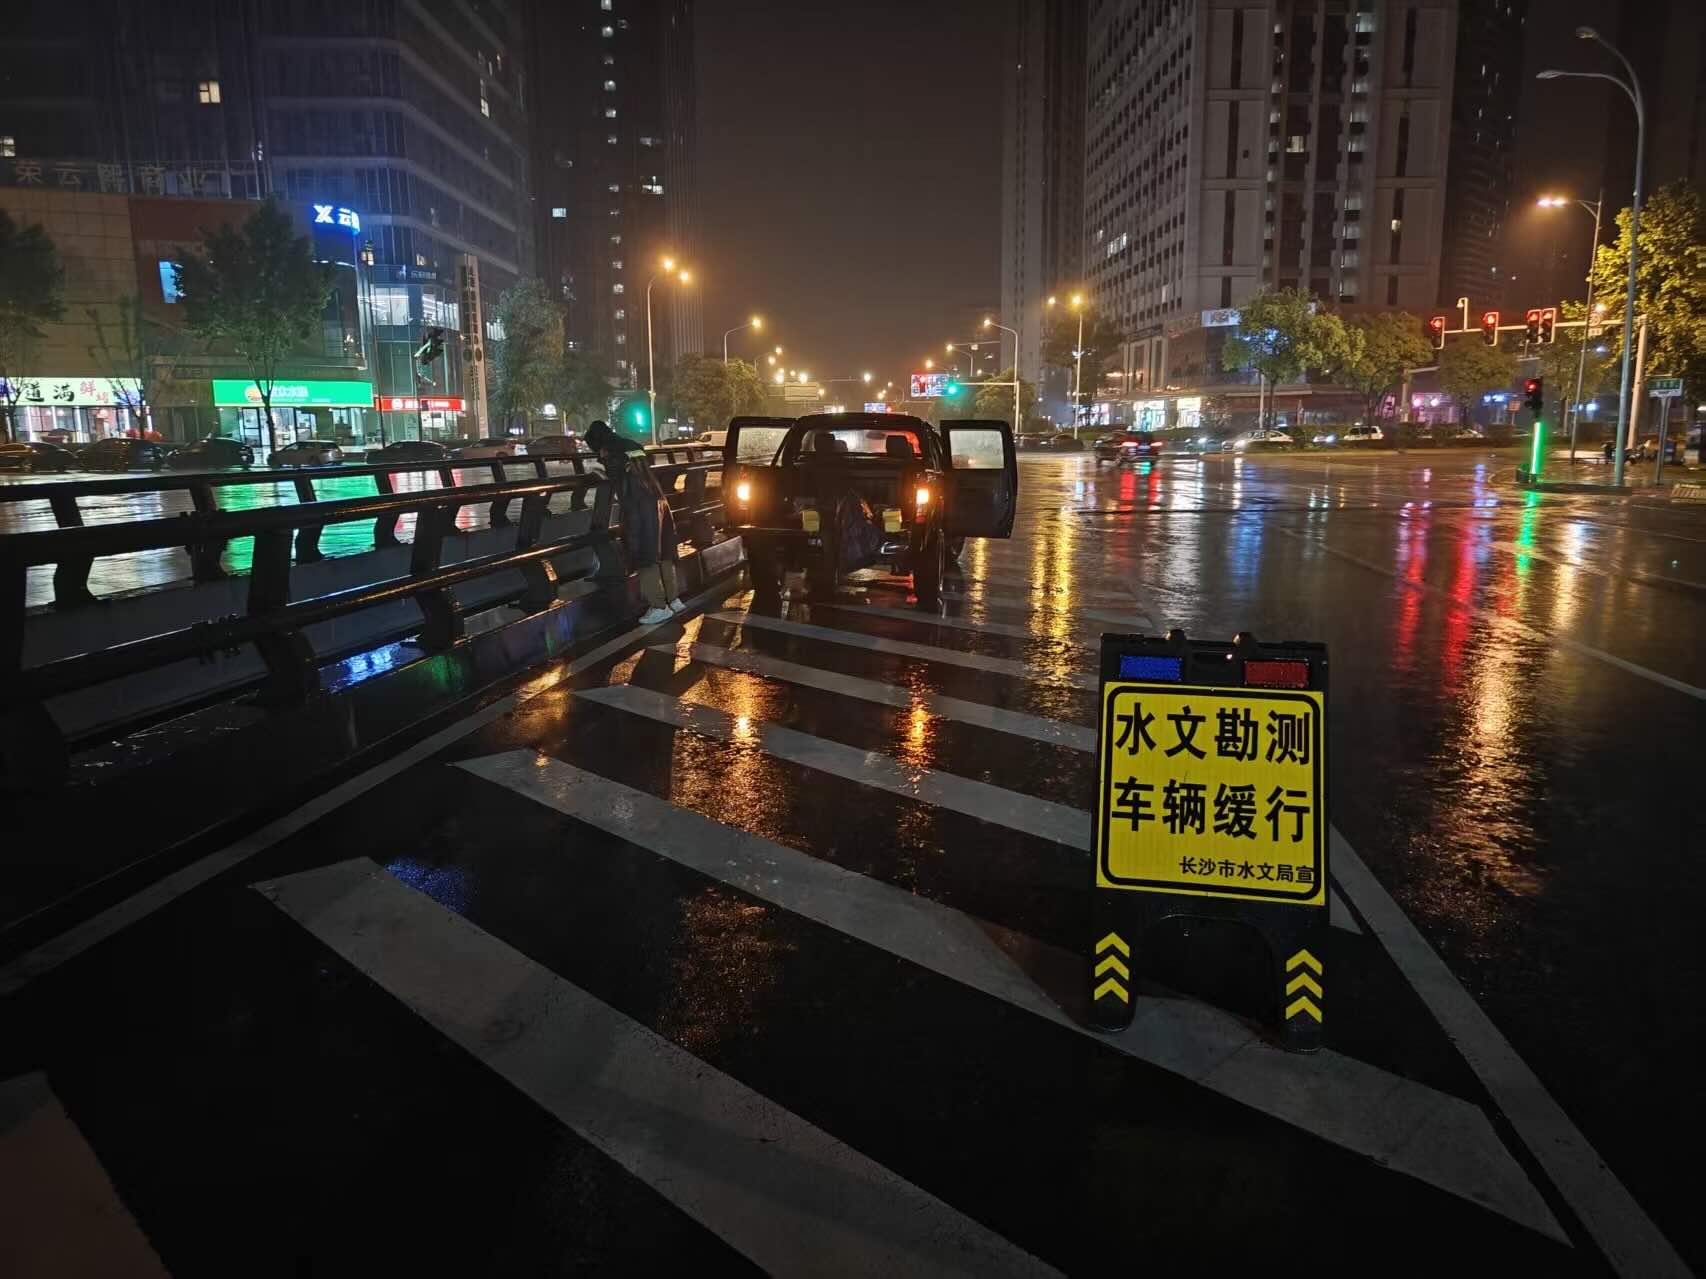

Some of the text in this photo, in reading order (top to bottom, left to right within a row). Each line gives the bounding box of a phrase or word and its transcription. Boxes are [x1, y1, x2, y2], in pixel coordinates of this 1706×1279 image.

[1115, 702, 1310, 765] 水文勘测
[1112, 775, 1310, 842] 车辆缓行
[1179, 855, 1315, 885] 长沙市水文局宣
